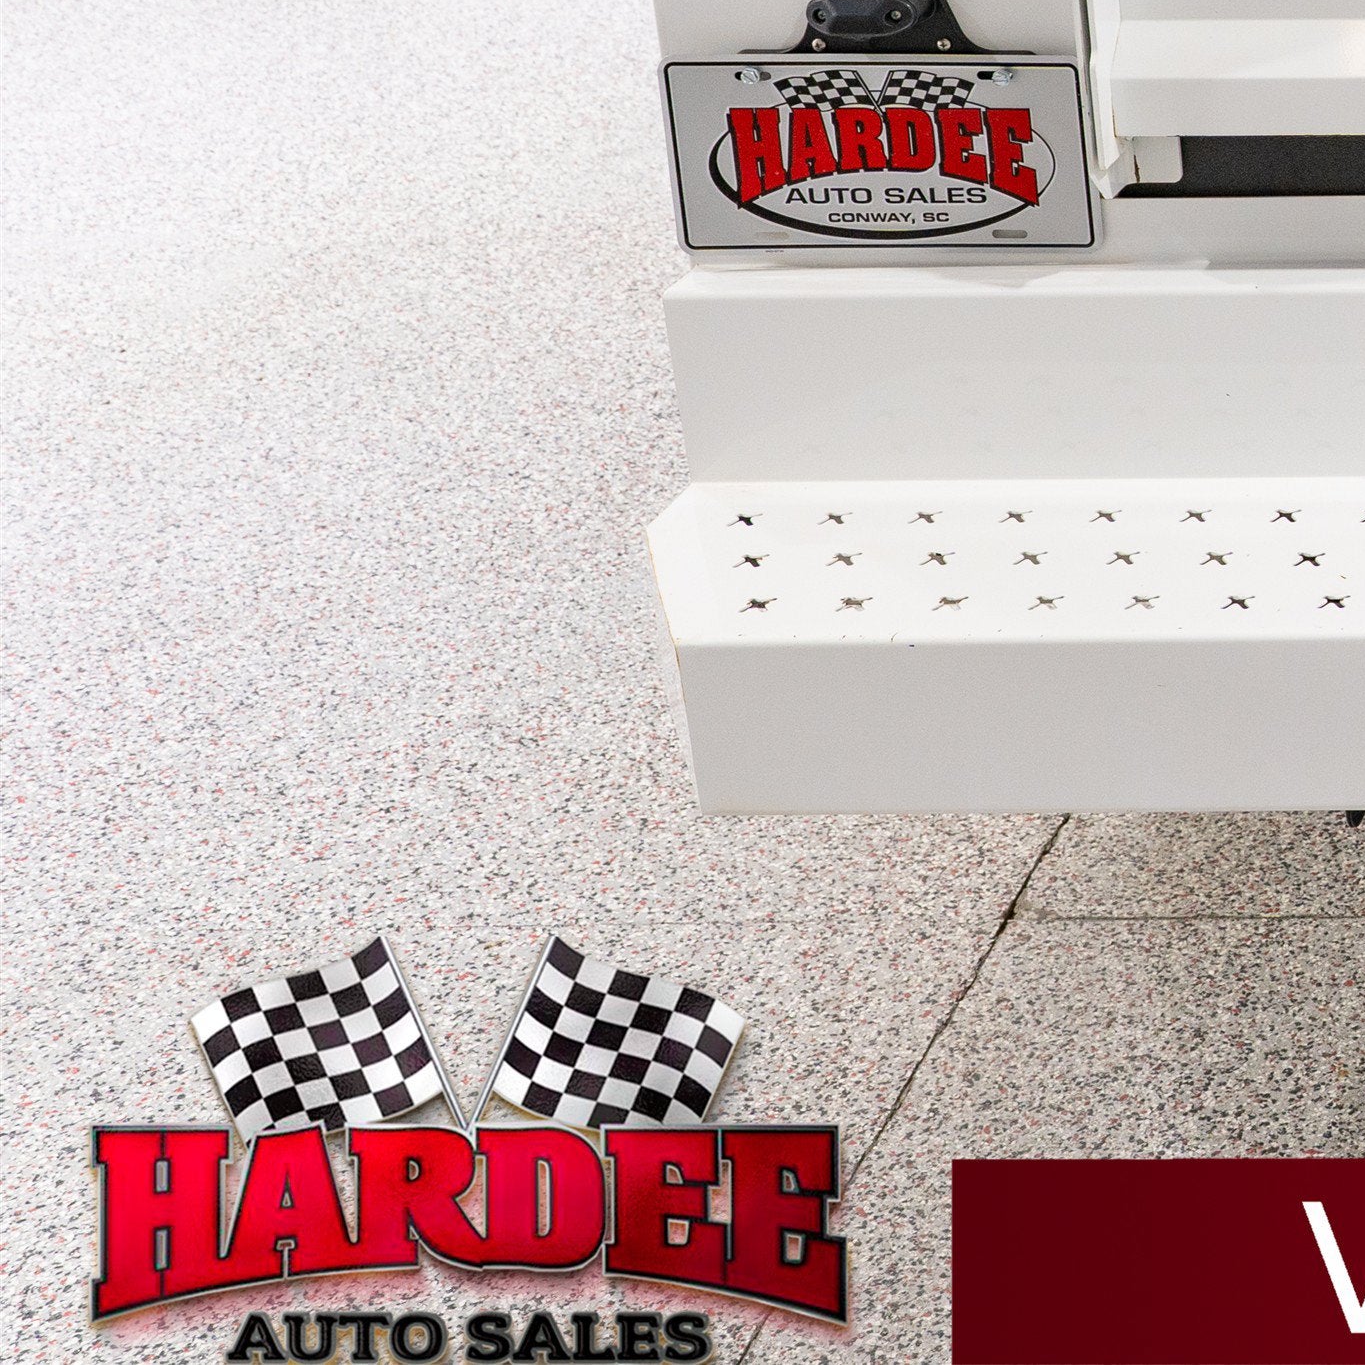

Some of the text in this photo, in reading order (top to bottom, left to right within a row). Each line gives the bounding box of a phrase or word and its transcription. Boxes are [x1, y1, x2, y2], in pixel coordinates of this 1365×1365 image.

[726, 107, 1040, 210] HARDEE
[785, 186, 988, 205] AUTO SALES
[827, 211, 951, 225] CONWAY, SC
